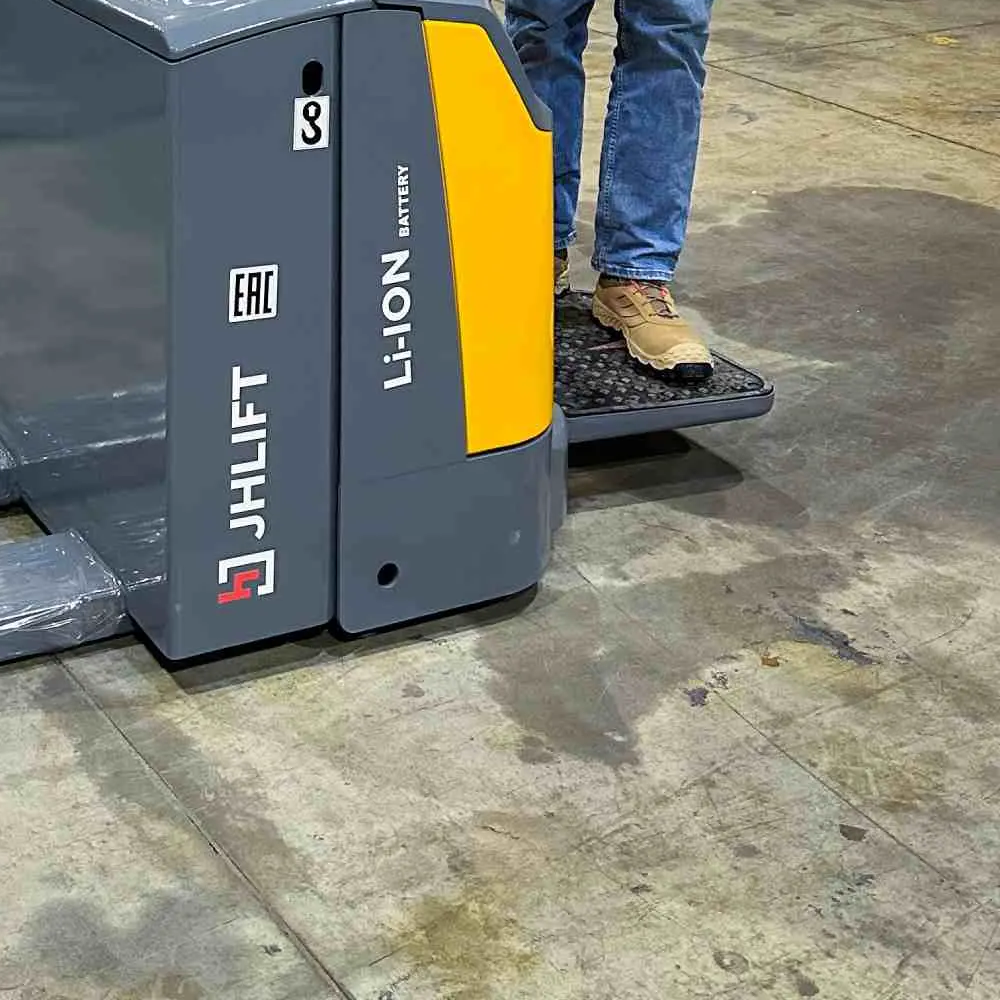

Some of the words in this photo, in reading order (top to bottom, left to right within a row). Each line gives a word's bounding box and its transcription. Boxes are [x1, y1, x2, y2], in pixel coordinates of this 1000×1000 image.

[234, 270, 274, 316] EAC
[381, 250, 412, 389] Li-ION
[397, 164, 410, 237] BATTERY
[229, 366, 268, 540] JHLIFT
